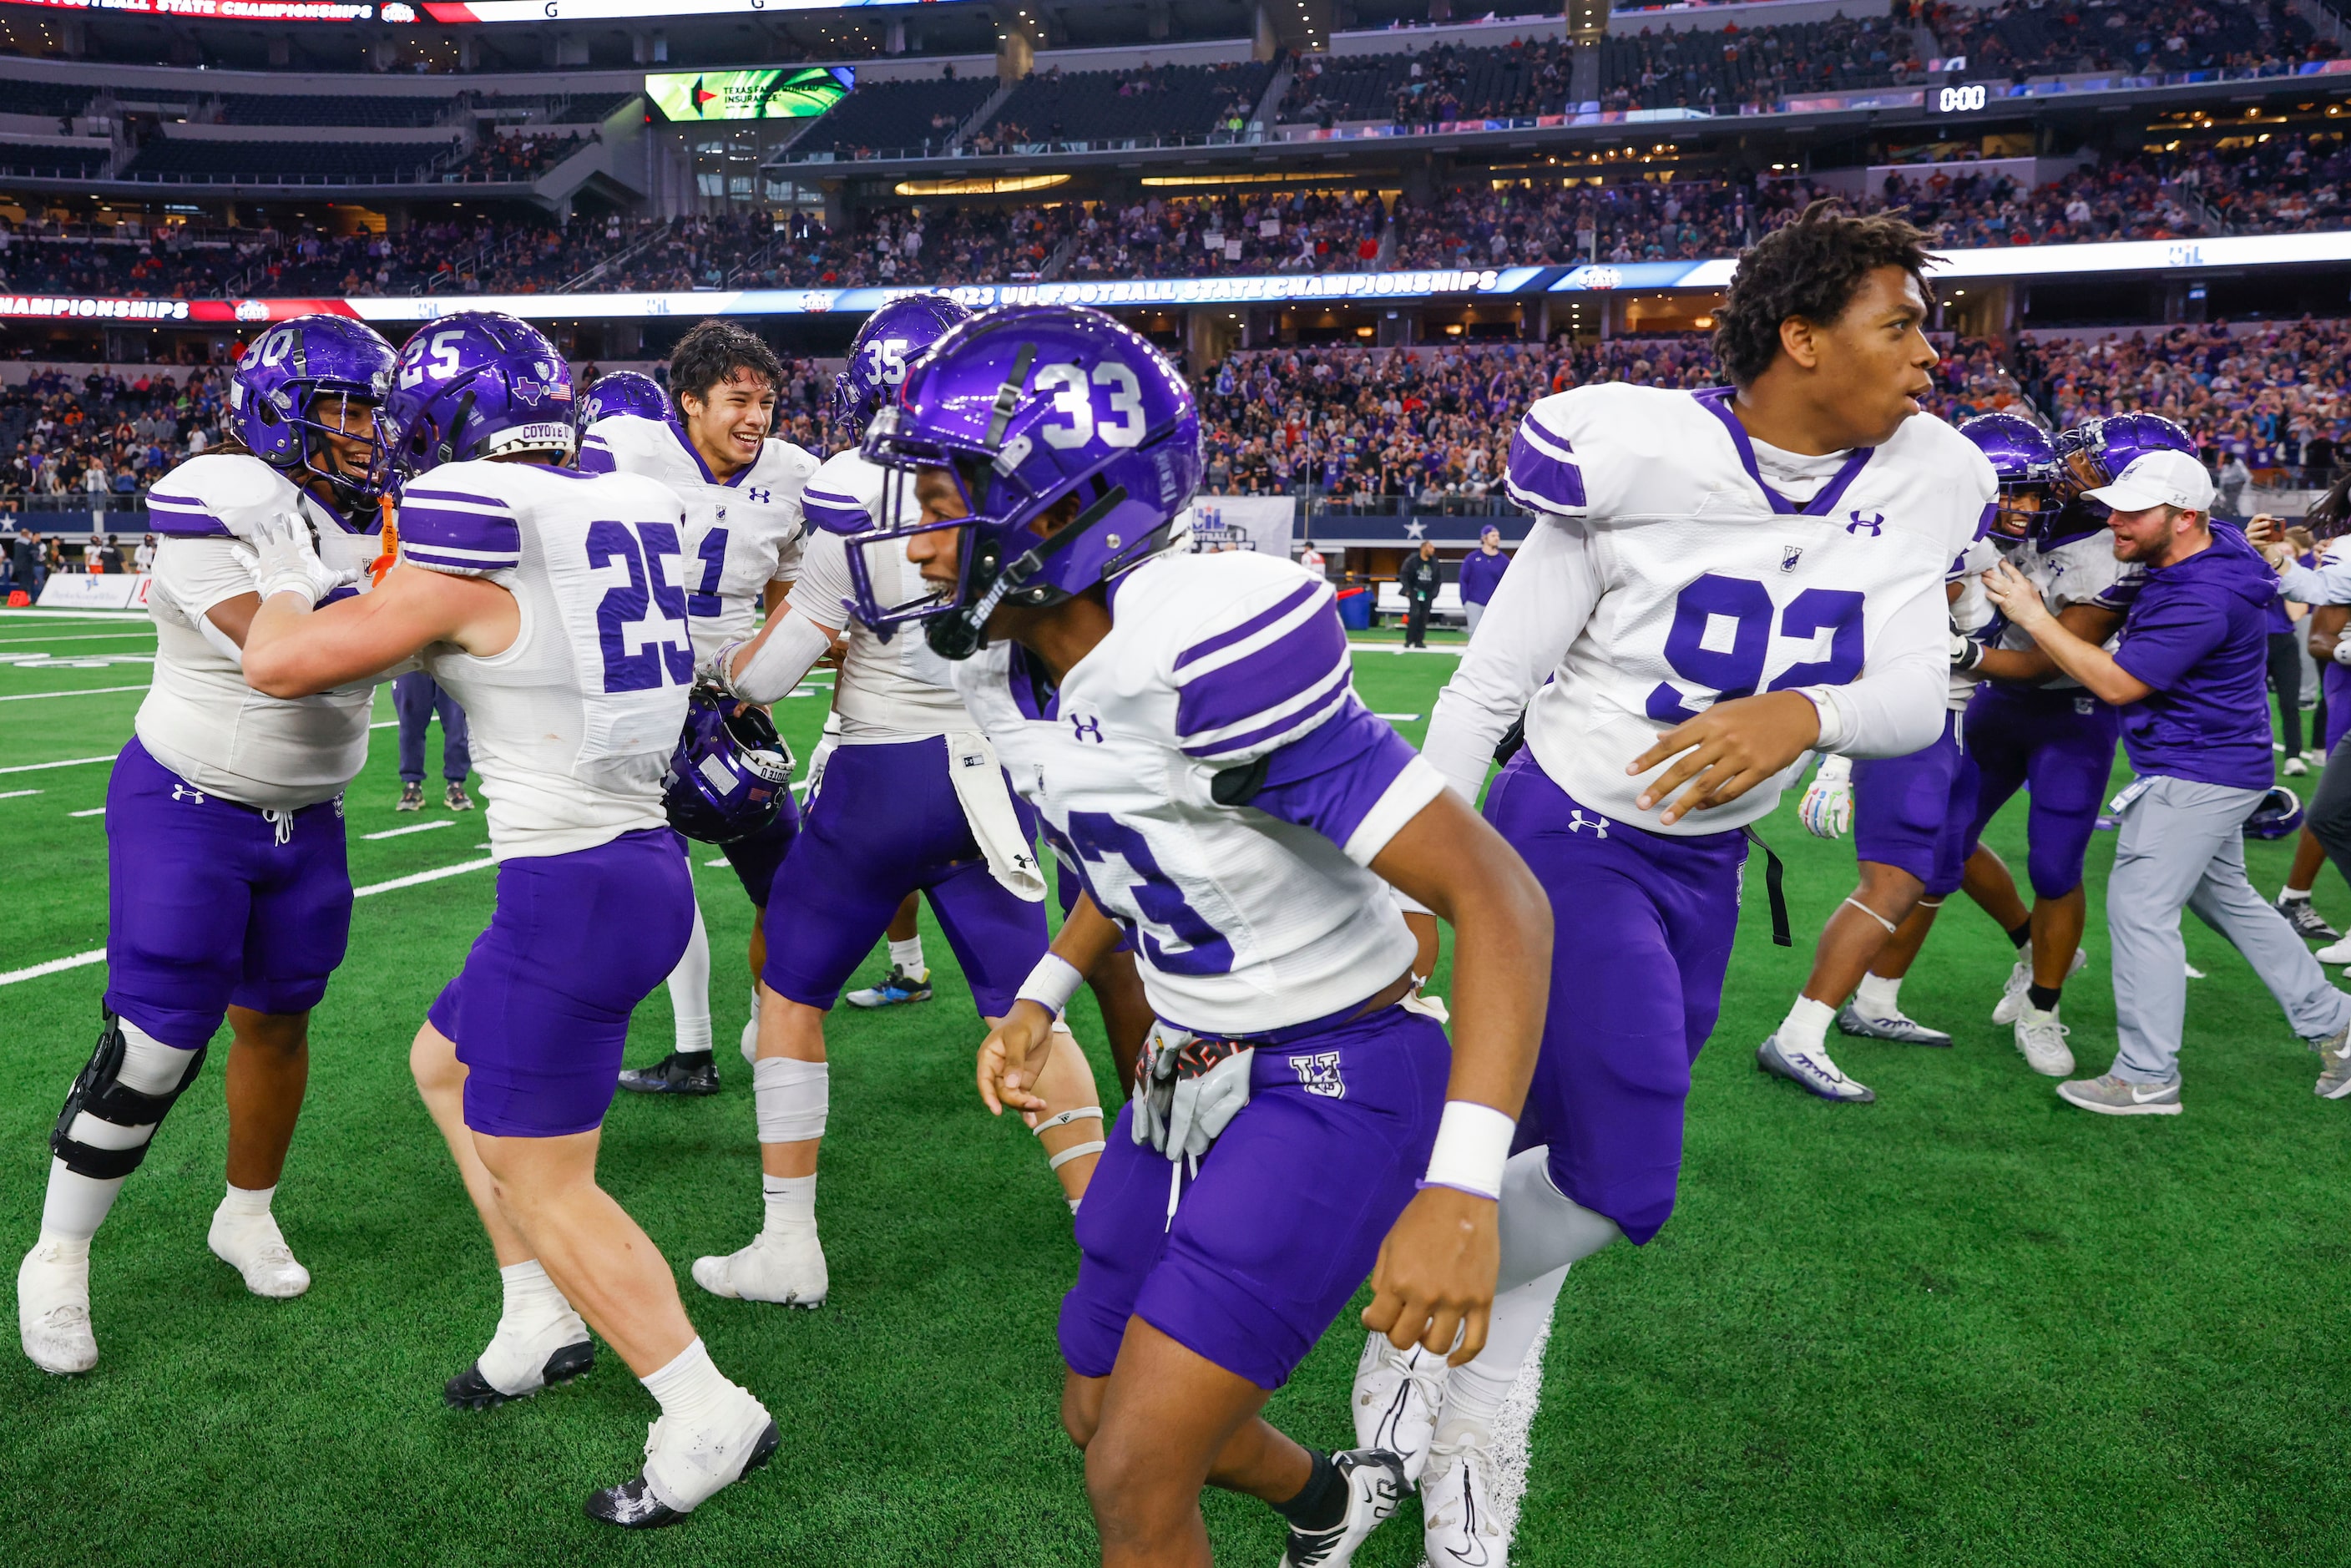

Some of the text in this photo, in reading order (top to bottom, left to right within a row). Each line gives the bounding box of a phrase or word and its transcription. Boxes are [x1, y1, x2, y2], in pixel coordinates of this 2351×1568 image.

[156, 0, 216, 13] STATE
[221, 2, 373, 19] CHAMPIONSHIPS
[544, 2, 559, 18] G
[724, 86, 752, 94] TEXAS
[725, 94, 778, 104] INSURACE
[1940, 85, 1985, 112] 0:00
[1000, 286, 1040, 304] UIL
[1048, 281, 1177, 303] FOOTBALL
[1181, 278, 1265, 300] STATE
[1271, 270, 1499, 297] CHAMPIONSHIPS
[0, 297, 189, 320] HAMPIONSHIPS
[240, 328, 301, 372] 90
[399, 330, 466, 391] 25
[863, 339, 908, 386] 35
[1034, 361, 1147, 450] 33
[523, 424, 562, 439] COYOTE
[687, 527, 729, 618] 1
[584, 519, 695, 694] 25
[1645, 572, 1866, 725] 92
